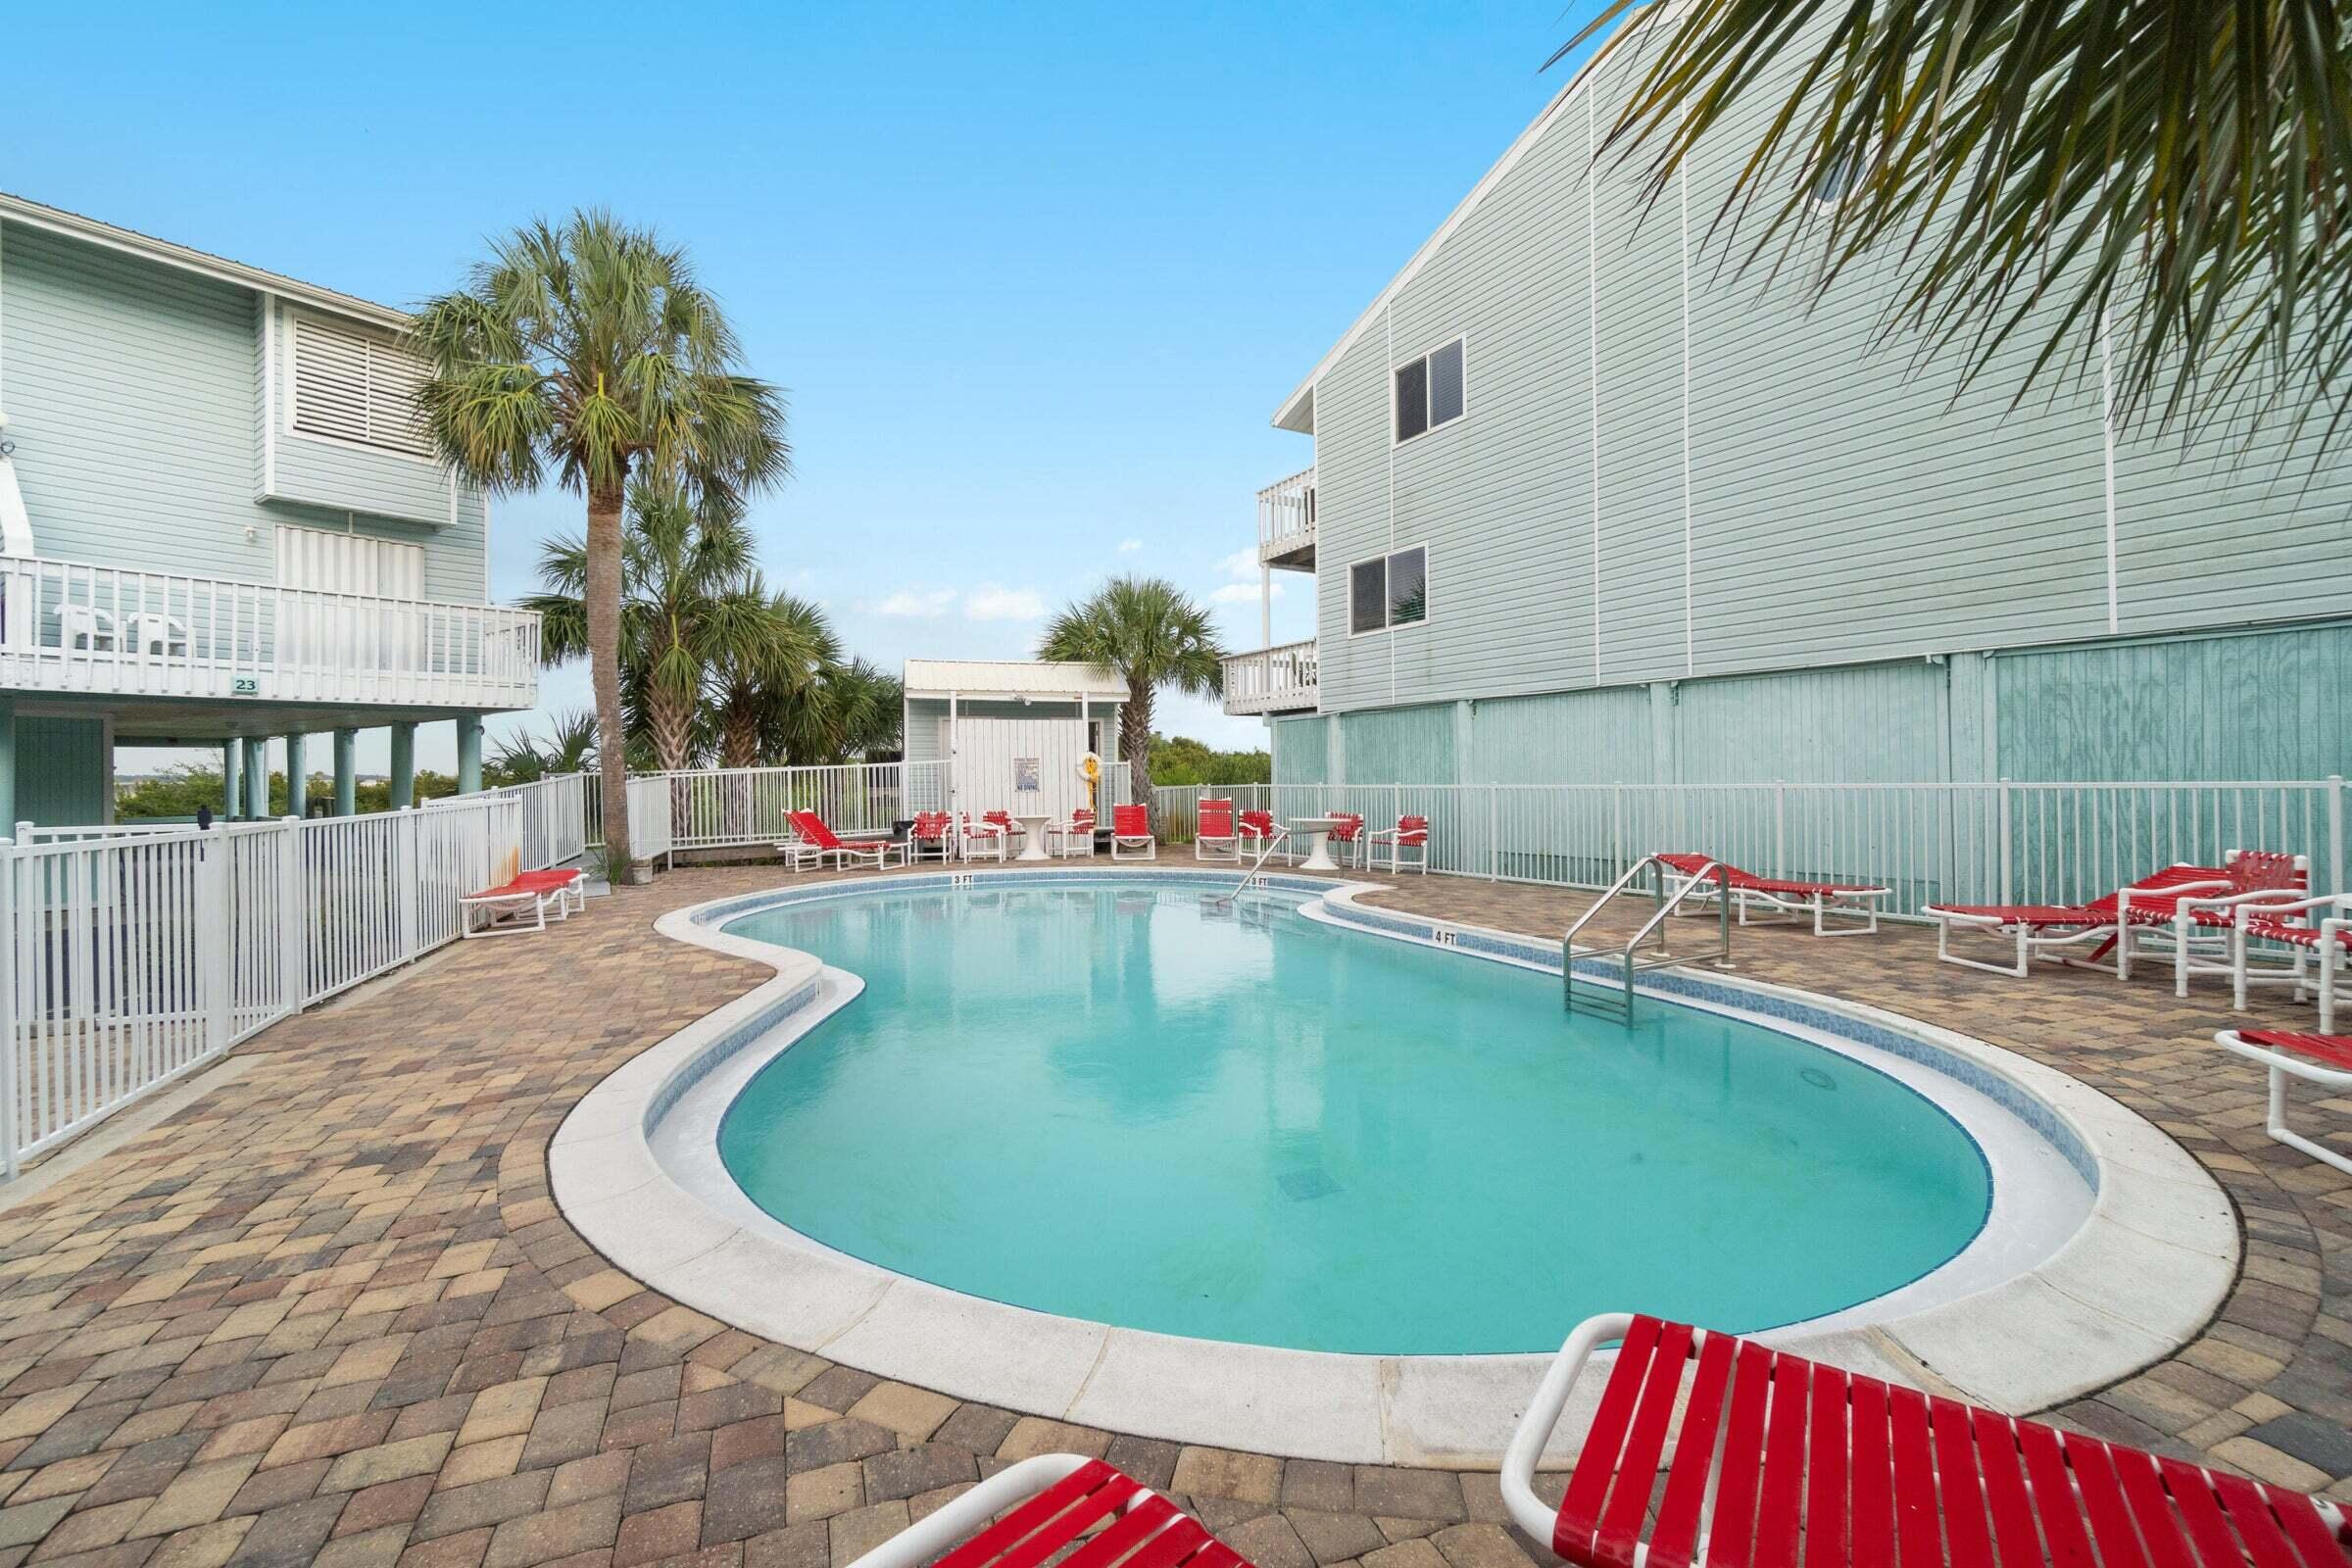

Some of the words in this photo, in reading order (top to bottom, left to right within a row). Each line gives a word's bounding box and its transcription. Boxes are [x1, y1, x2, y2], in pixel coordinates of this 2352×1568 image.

[236, 679, 256, 690] 23
[955, 875, 960, 884] 3
[963, 874, 973, 884] FT
[1259, 877, 1267, 886] FT
[1436, 930, 1442, 943] 4
[1445, 932, 1455, 946] FT
